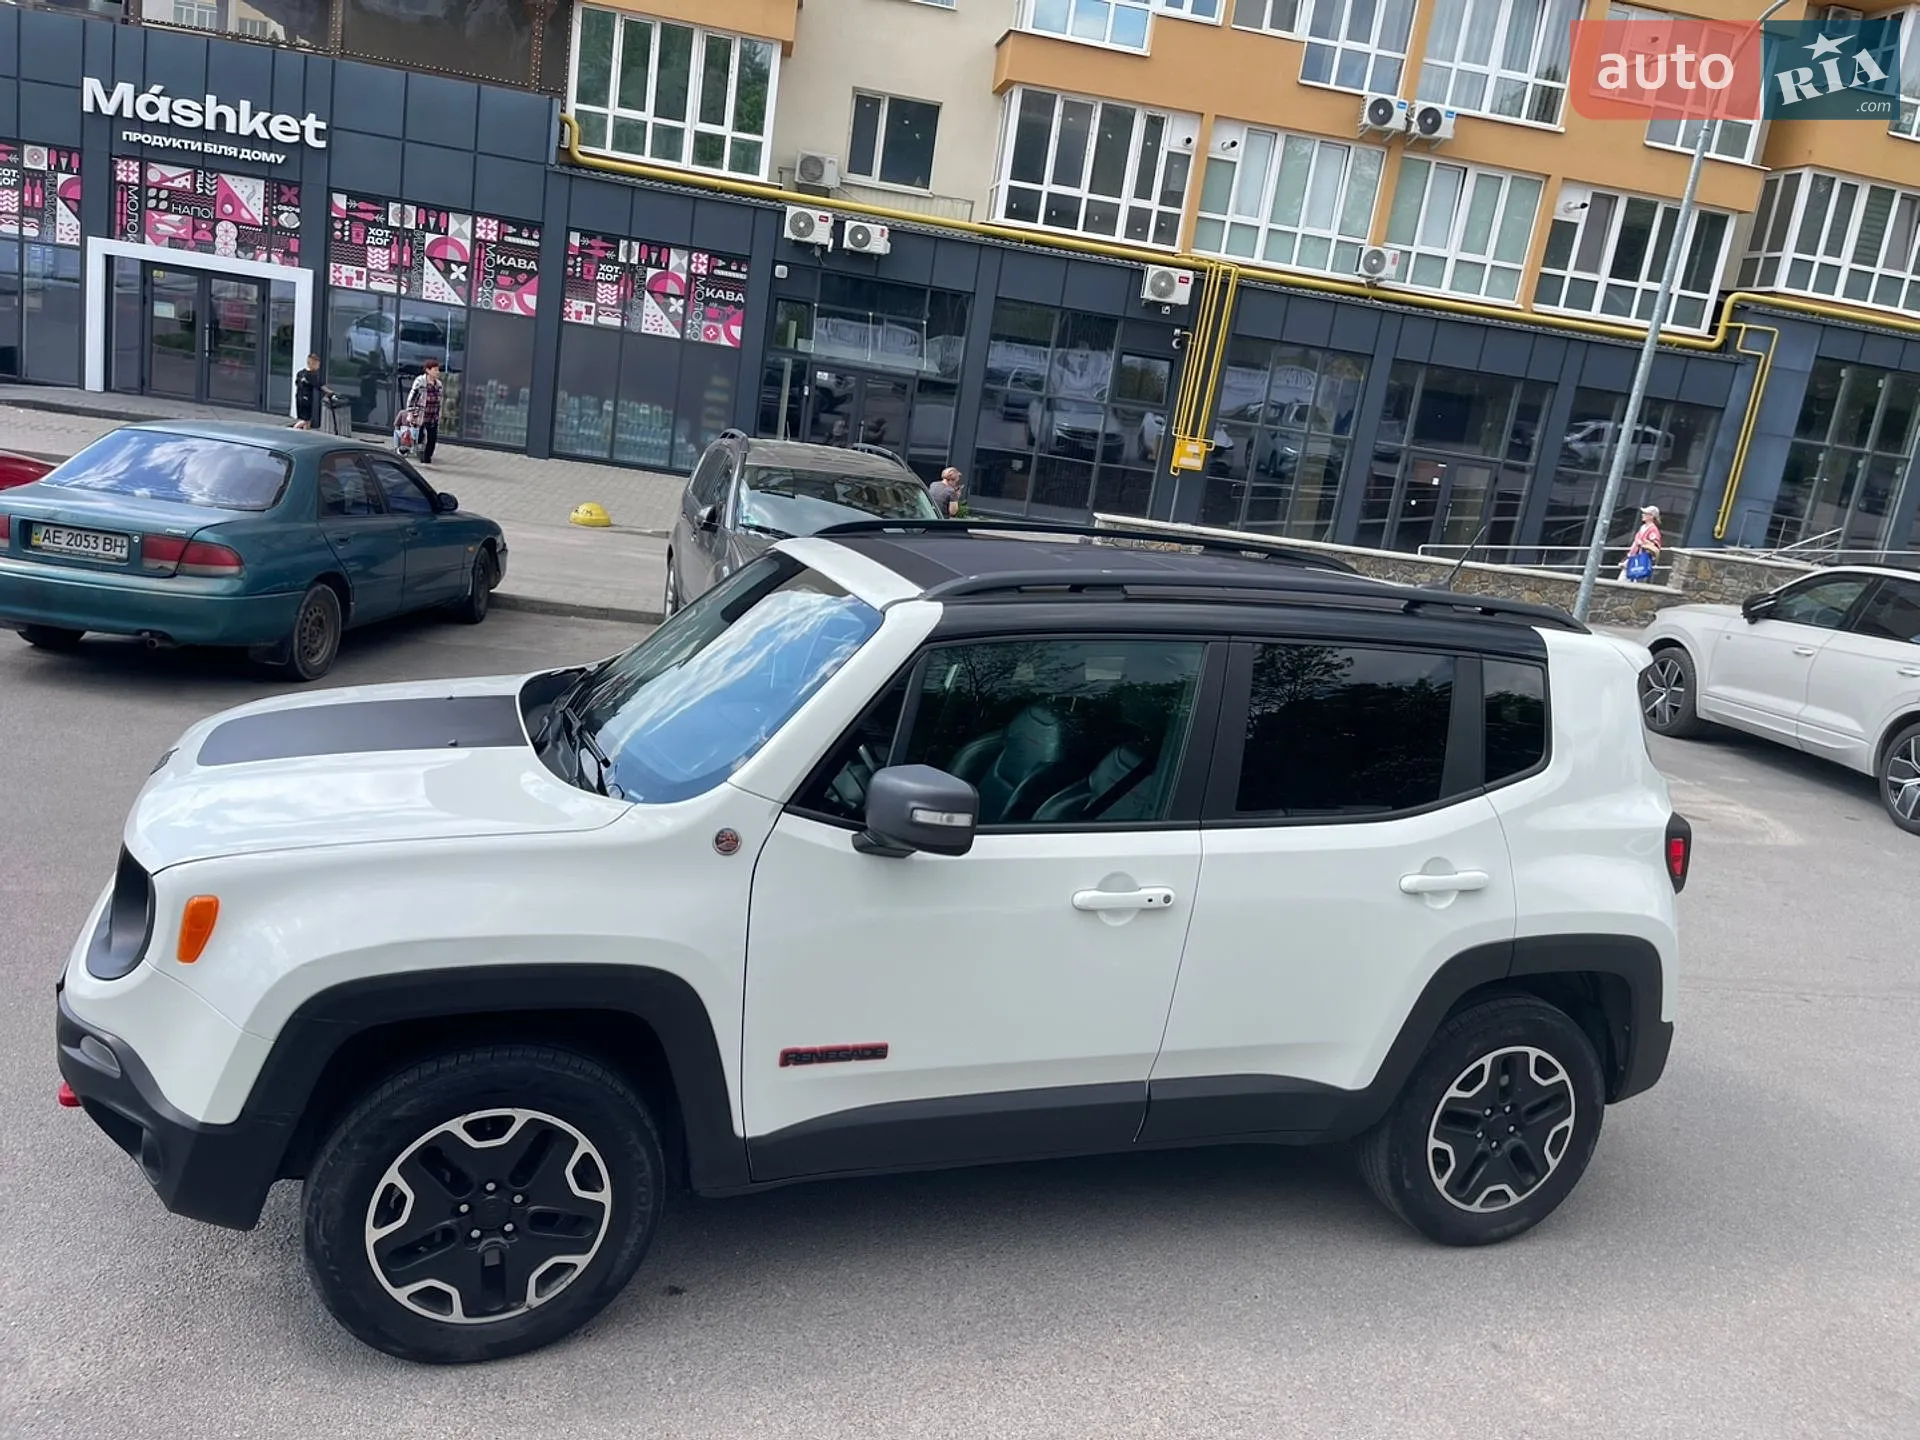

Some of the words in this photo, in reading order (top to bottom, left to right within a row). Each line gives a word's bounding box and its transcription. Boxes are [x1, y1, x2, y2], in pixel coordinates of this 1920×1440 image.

[82, 77, 327, 148] Máshket
[121, 130, 201, 152] ПРОДУКТИ
[203, 142, 239, 159] БІЛЯ
[238, 147, 287, 165] ДОМУ
[0, 167, 20, 179] ОТ.
[0, 177, 18, 186] ОГ
[126, 185, 139, 243] МОЛОК
[481, 242, 497, 310] МОЛОКО
[496, 254, 539, 272] КАВА
[705, 287, 745, 304] КАВА
[41, 528, 63, 546] AE
[66, 532, 100, 551] 2053
[102, 536, 126, 555] BH
